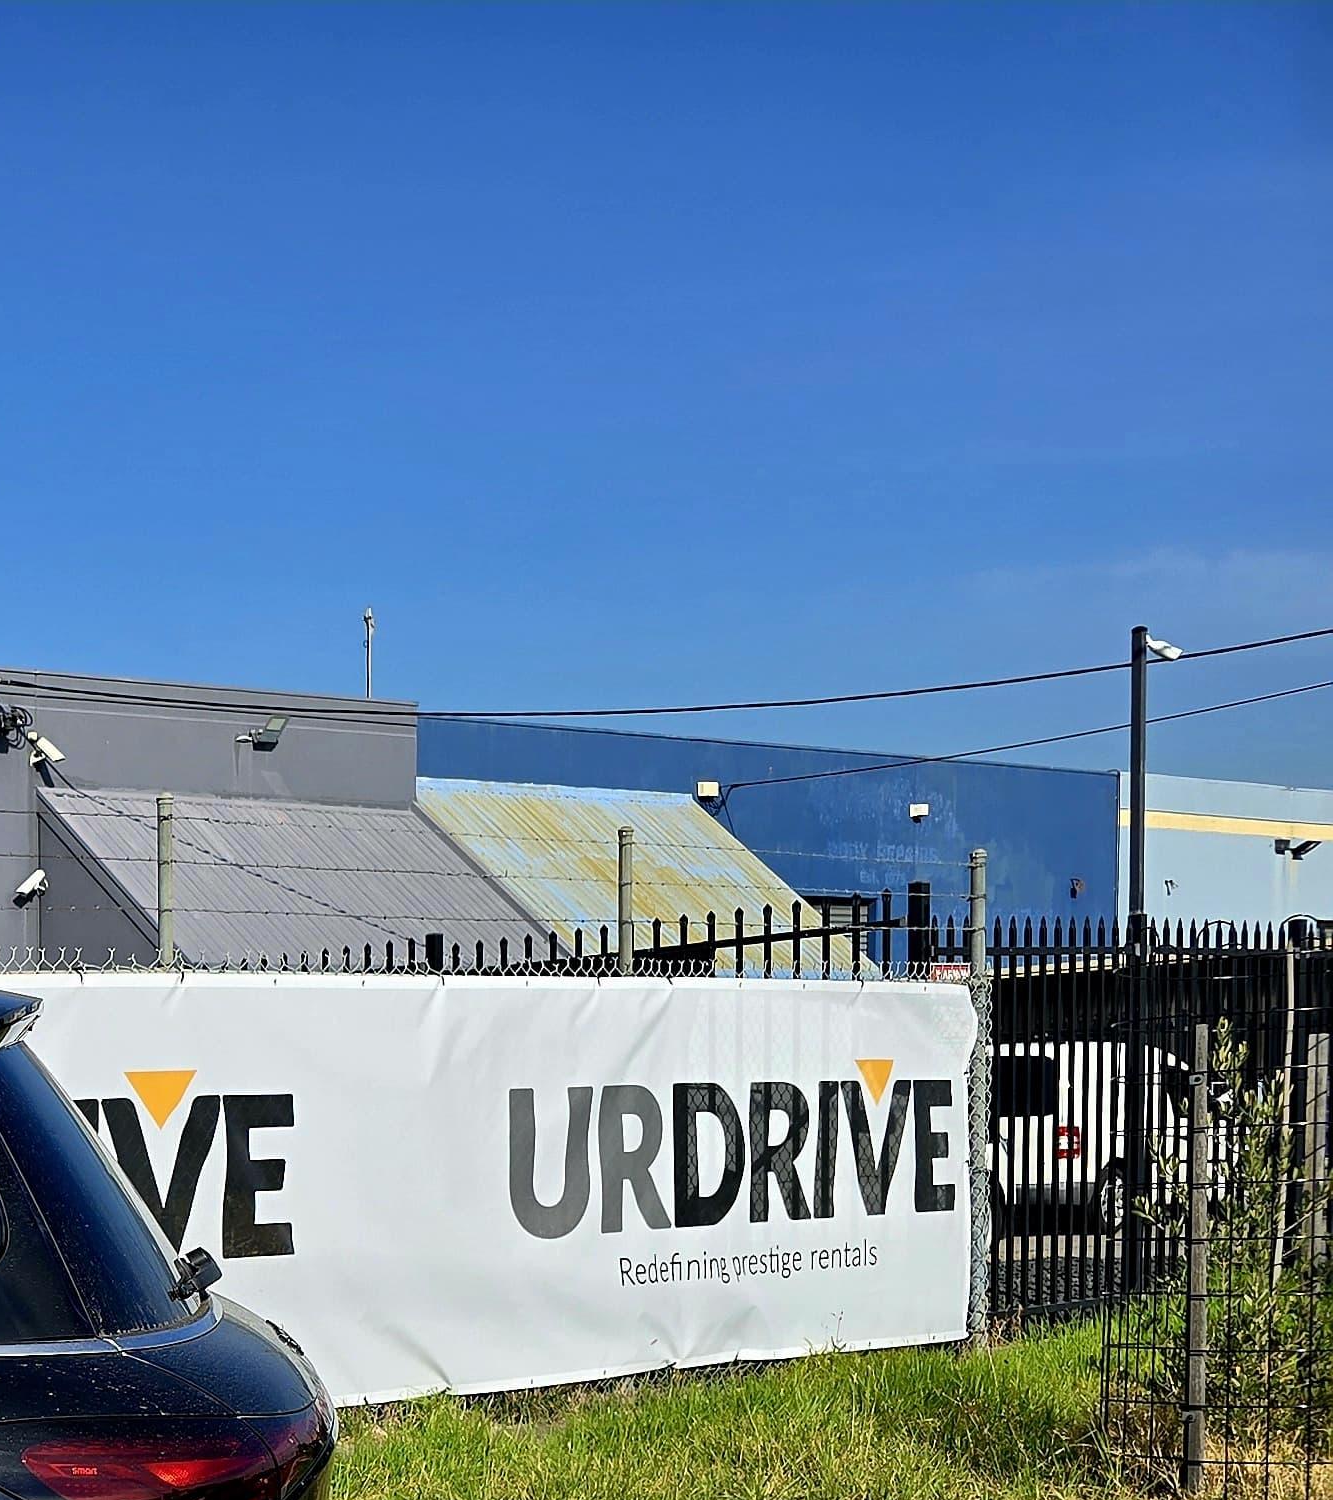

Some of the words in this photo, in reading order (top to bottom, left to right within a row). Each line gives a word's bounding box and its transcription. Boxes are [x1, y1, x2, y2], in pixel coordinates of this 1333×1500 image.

[73, 1094, 295, 1259] VE
[509, 1080, 955, 1239] URDRIVE
[619, 1251, 731, 1287] Redefining
[732, 1245, 803, 1283] prestige
[810, 1238, 878, 1271] rentals
